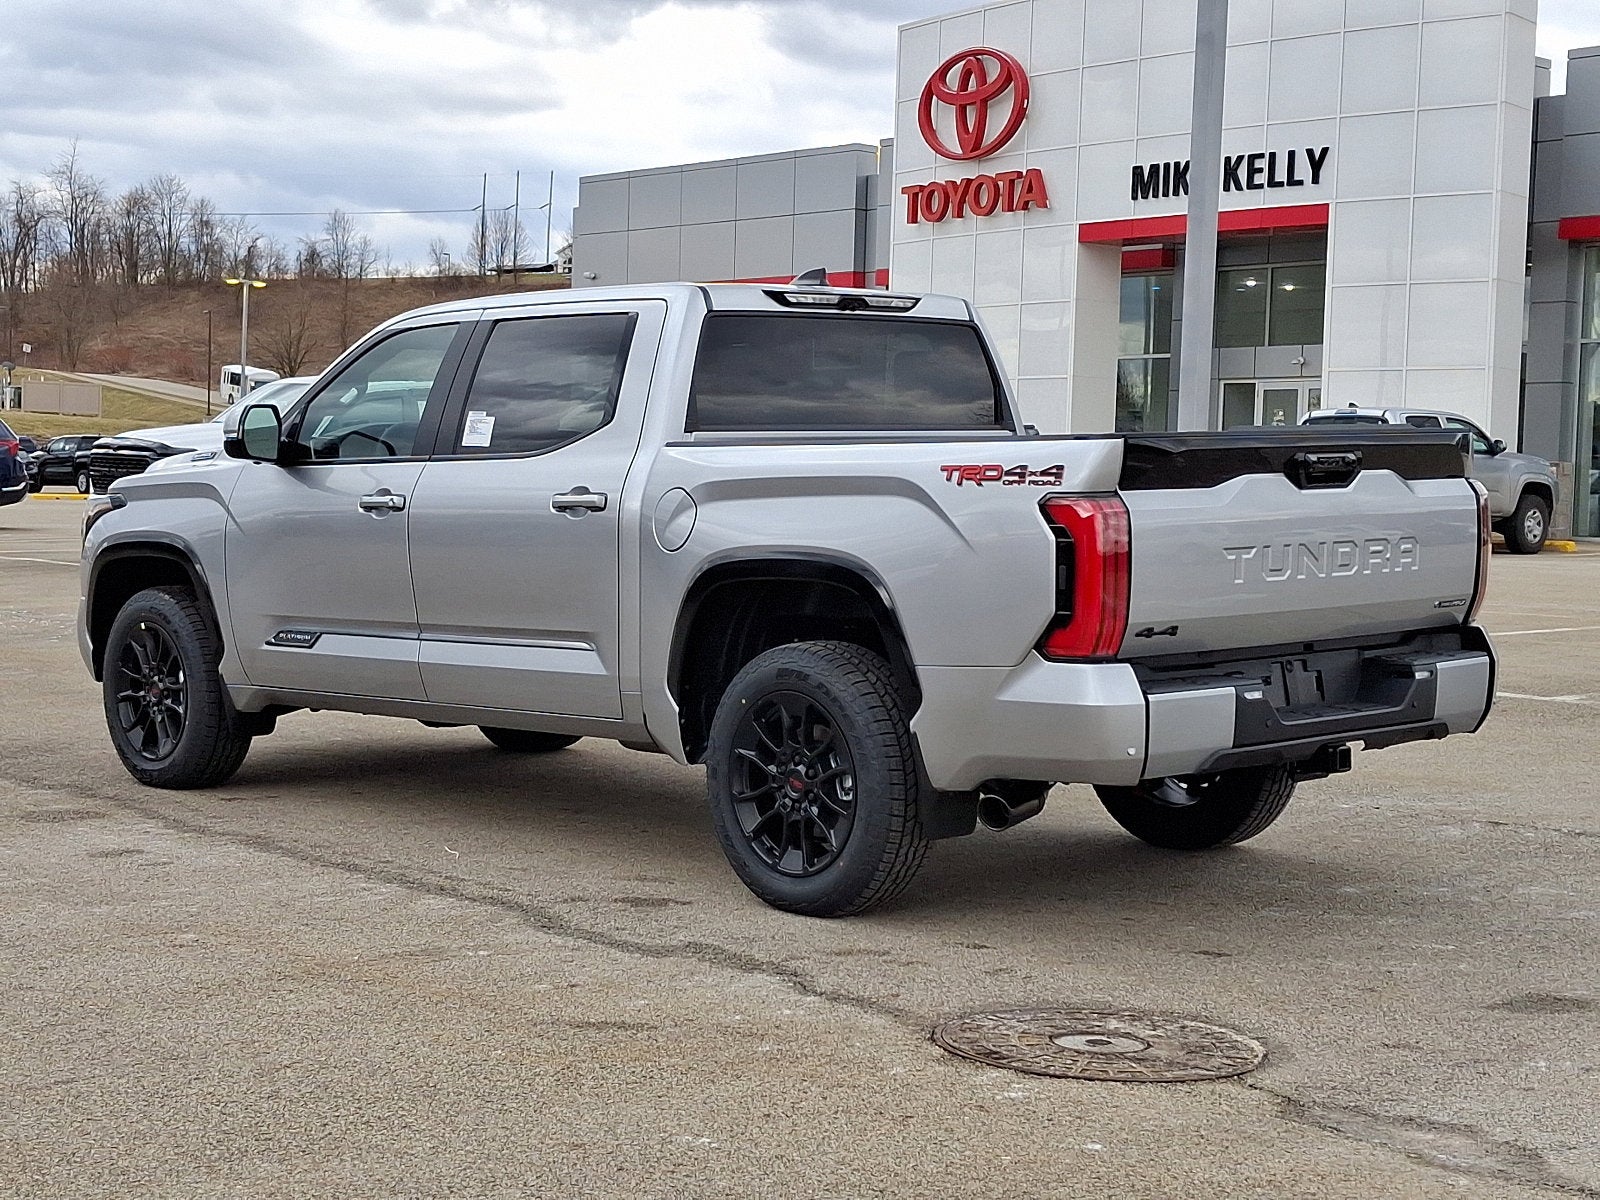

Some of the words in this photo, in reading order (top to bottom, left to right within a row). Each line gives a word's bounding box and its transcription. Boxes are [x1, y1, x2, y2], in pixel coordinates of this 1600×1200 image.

[901, 168, 1050, 224] TOYOTA
[1131, 160, 1191, 201] MIK
[1223, 147, 1330, 192] KELLY
[940, 464, 1003, 487] TRD
[1222, 536, 1420, 584] TUNDRA
